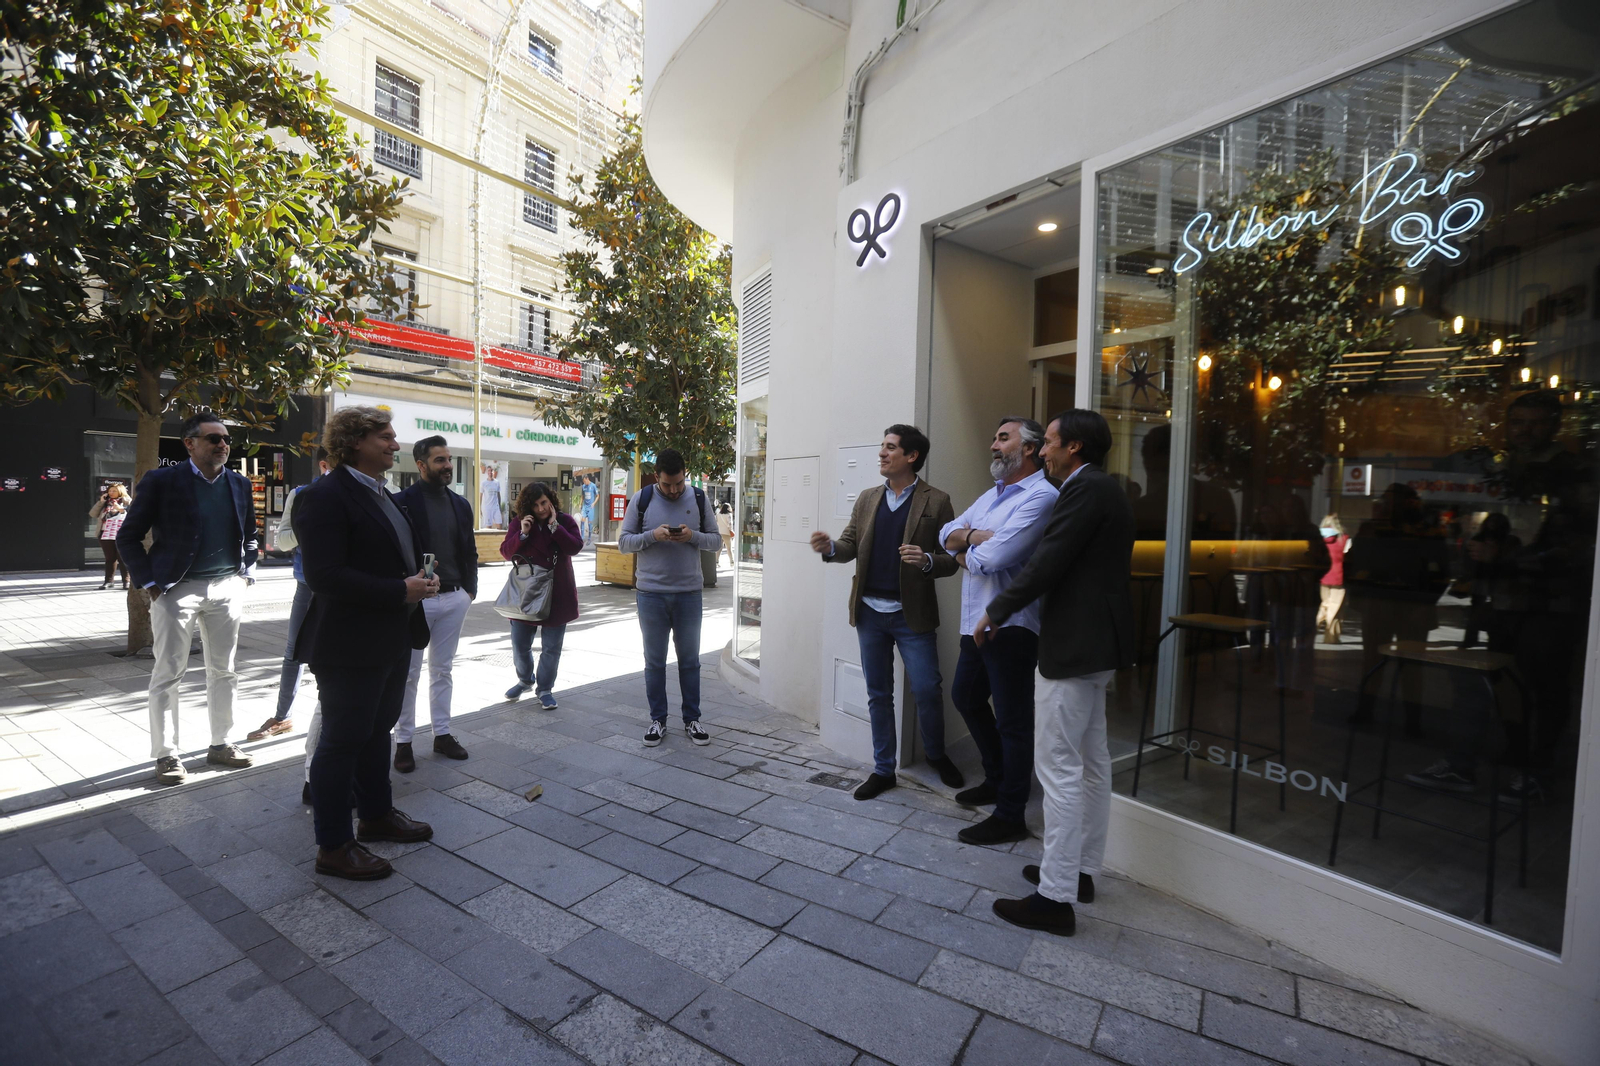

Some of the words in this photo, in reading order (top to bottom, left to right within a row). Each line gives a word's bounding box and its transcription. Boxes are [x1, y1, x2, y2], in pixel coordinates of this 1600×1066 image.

[1173, 204, 1340, 273] Silbon
[1350, 152, 1476, 225] Bar
[534, 359, 546, 367] 957
[548, 362, 560, 370] 472
[415, 418, 459, 433] TIENDA
[461, 423, 503, 438] OFCIAL
[566, 436, 579, 446] CF
[1207, 745, 1348, 803] SILBON
